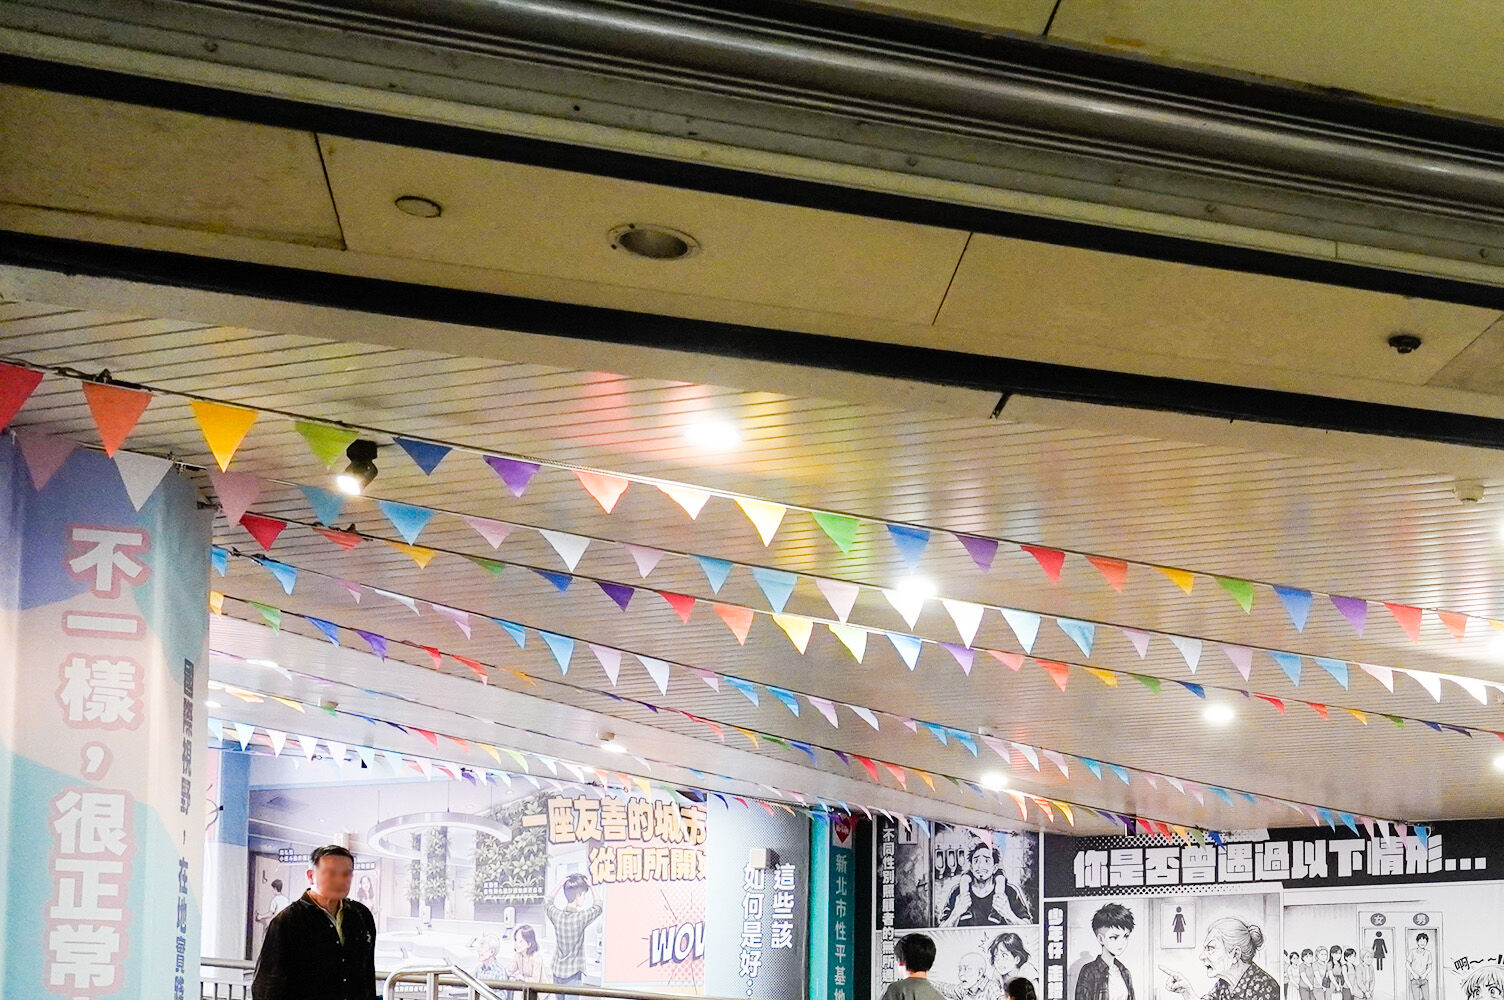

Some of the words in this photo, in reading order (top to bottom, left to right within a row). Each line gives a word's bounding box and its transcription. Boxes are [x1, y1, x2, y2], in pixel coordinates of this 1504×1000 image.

[522, 794, 707, 845] 一座友善的城市
[770, 863, 796, 949] 這些該
[1372, 914, 1385, 926] 女
[1416, 914, 1427, 926] 男
